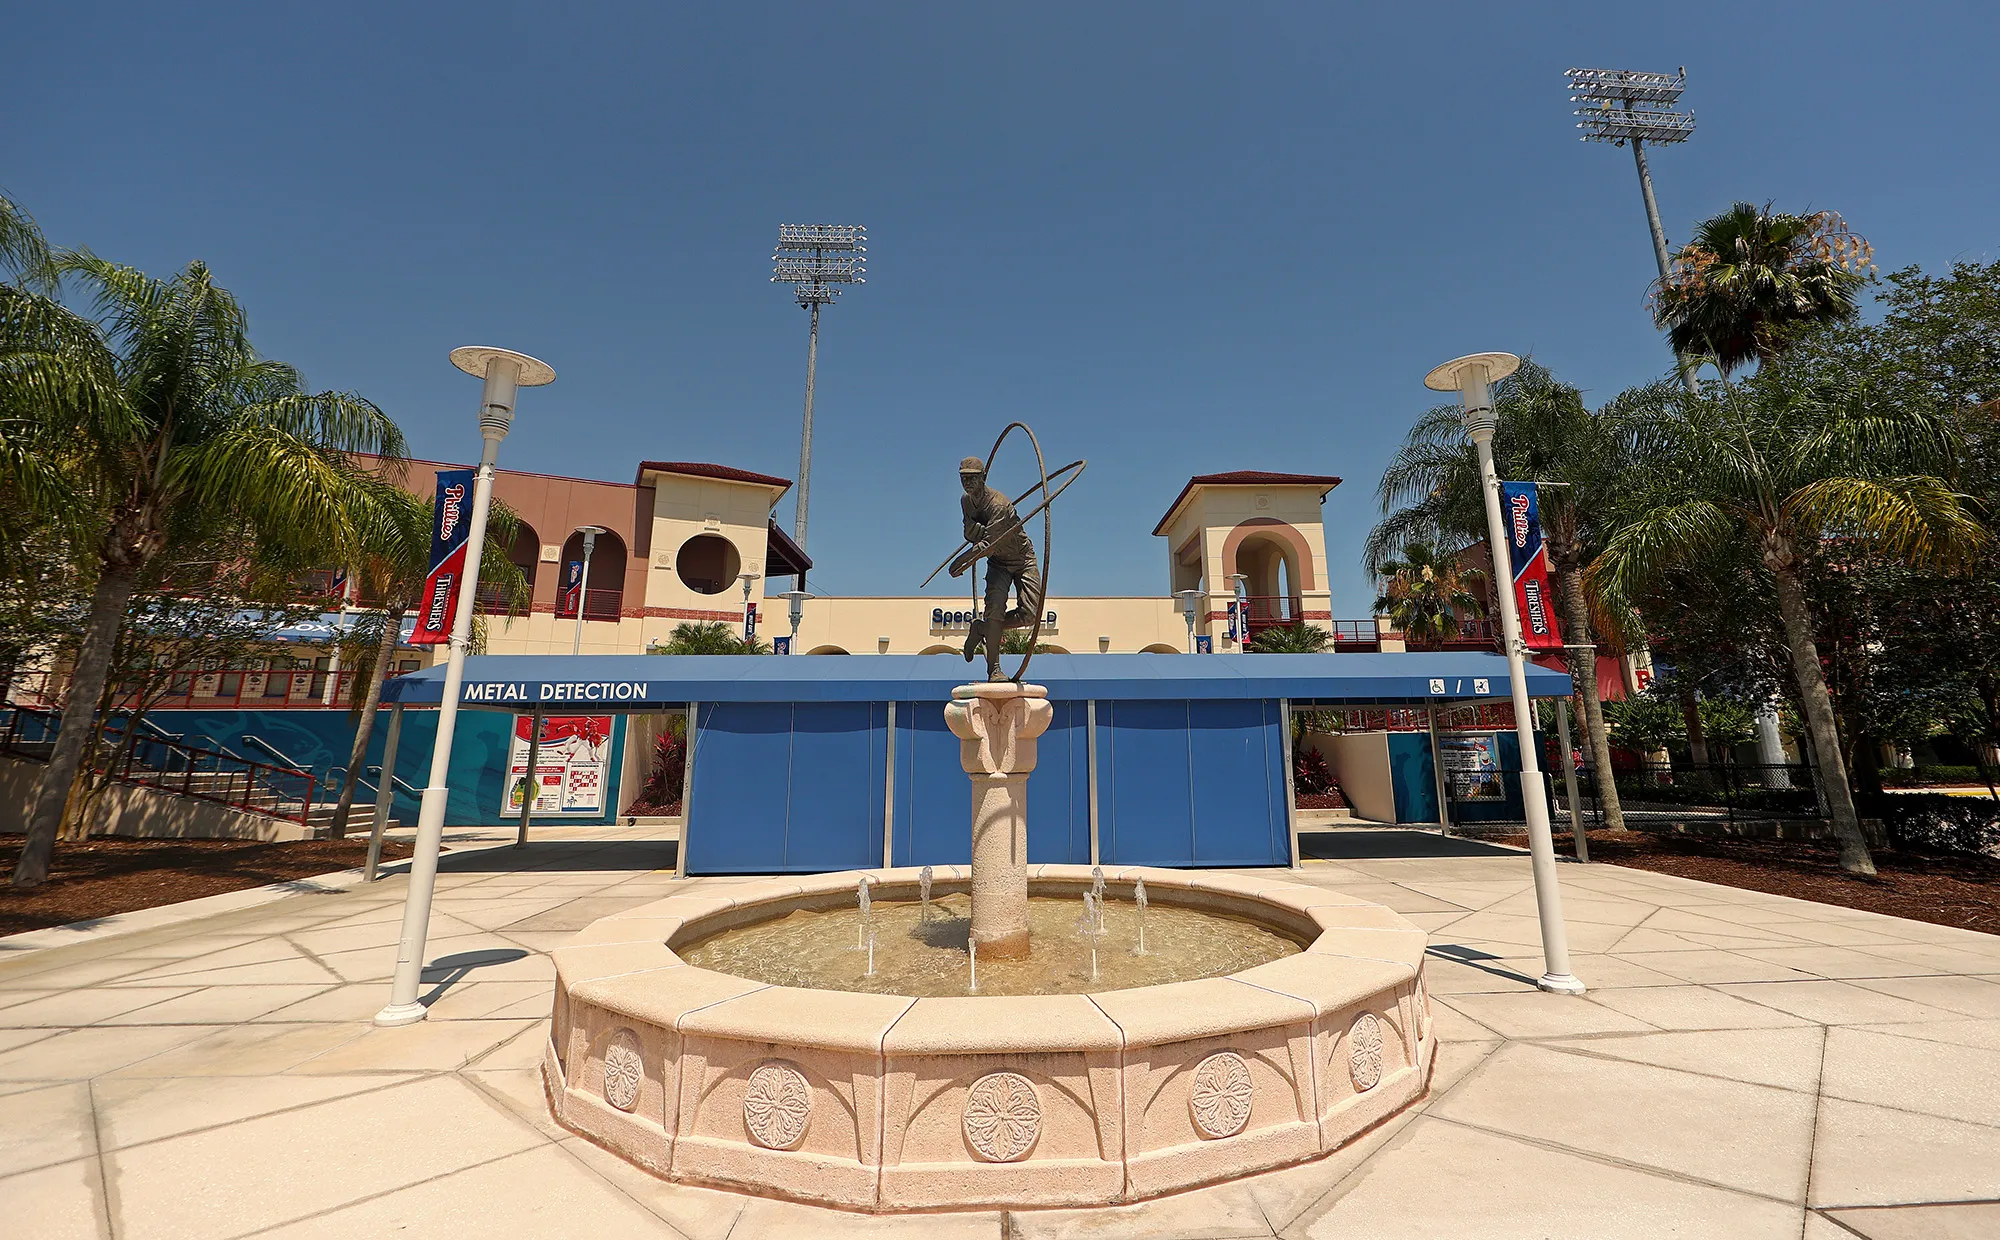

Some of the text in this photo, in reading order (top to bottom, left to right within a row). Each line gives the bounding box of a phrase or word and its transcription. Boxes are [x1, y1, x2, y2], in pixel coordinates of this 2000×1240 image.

[440, 483, 465, 541] Phillies
[1511, 494, 1530, 548] Phillies
[425, 574, 453, 631] THRESHERS
[1525, 581, 1547, 634] THRESHERS
[464, 683, 647, 700] METAL DETECTION
